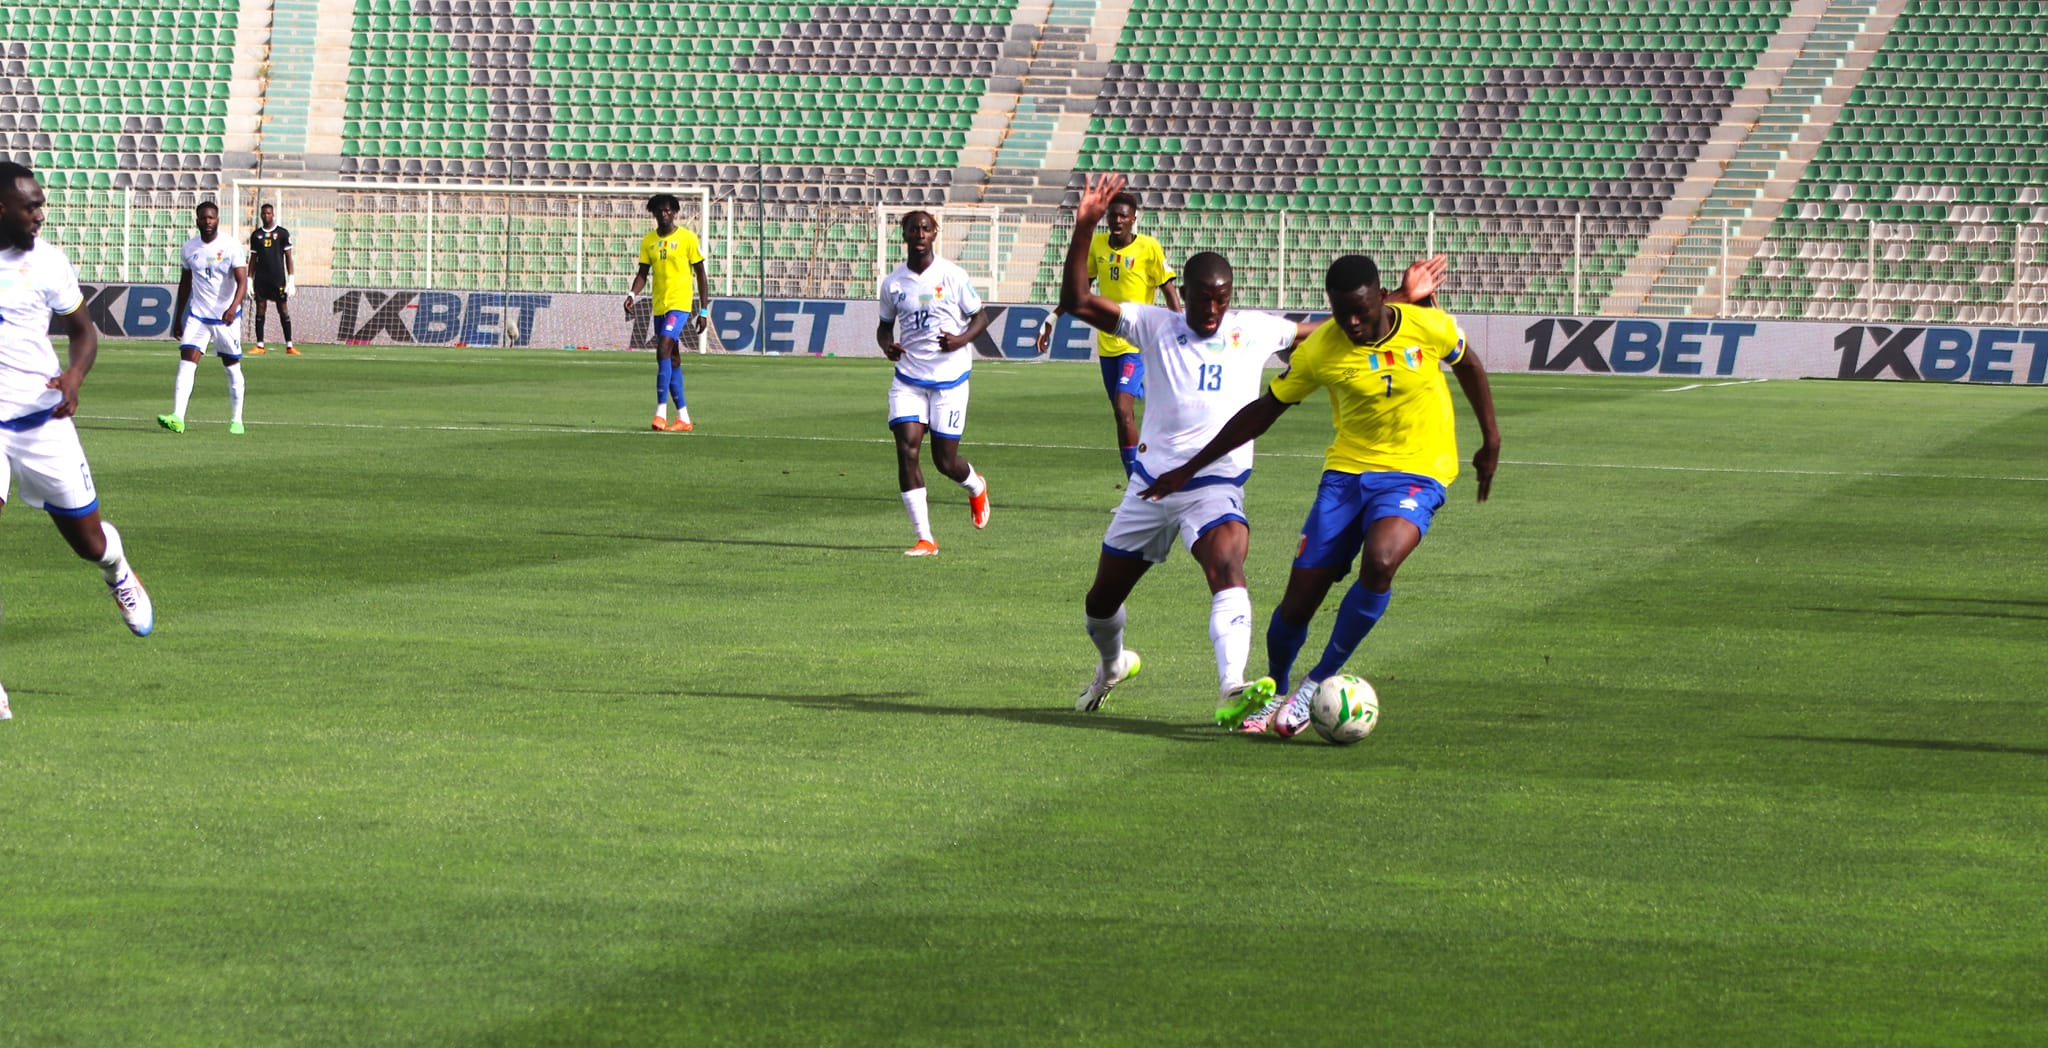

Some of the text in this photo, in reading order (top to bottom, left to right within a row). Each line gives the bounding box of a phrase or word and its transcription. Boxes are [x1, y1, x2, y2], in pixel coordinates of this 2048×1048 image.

[205, 267, 212, 280] 9
[1109, 266, 1120, 281] 19
[333, 290, 552, 347] 1XBET
[911, 310, 930, 330] 12
[1525, 318, 1757, 376] 1XBET
[1834, 326, 2048, 384] 1XBET
[1197, 363, 1223, 391] 13
[1381, 374, 1393, 398] 7
[948, 410, 961, 428] 12
